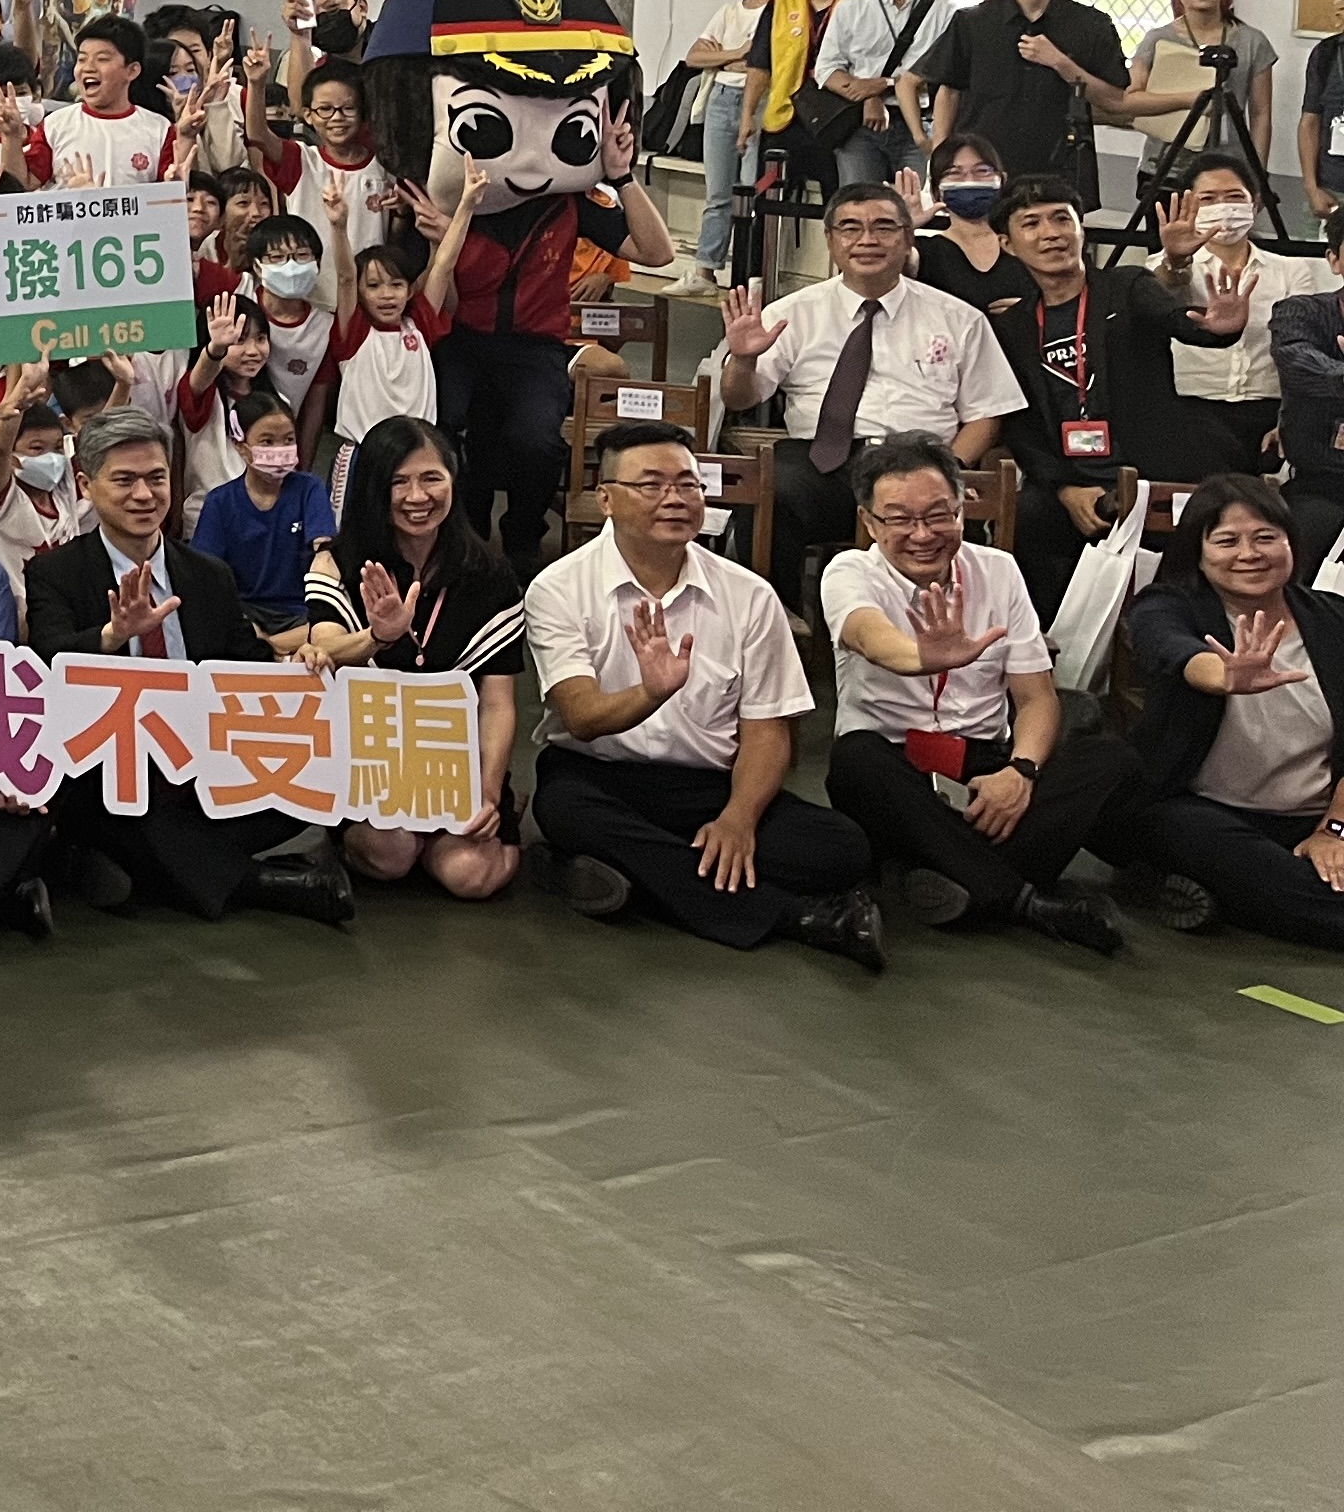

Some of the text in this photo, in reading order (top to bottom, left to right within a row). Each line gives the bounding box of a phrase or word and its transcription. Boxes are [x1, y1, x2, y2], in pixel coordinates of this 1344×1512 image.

[16, 196, 140, 225] 防詐騙3C原則
[31, 318, 145, 352] Call 165
